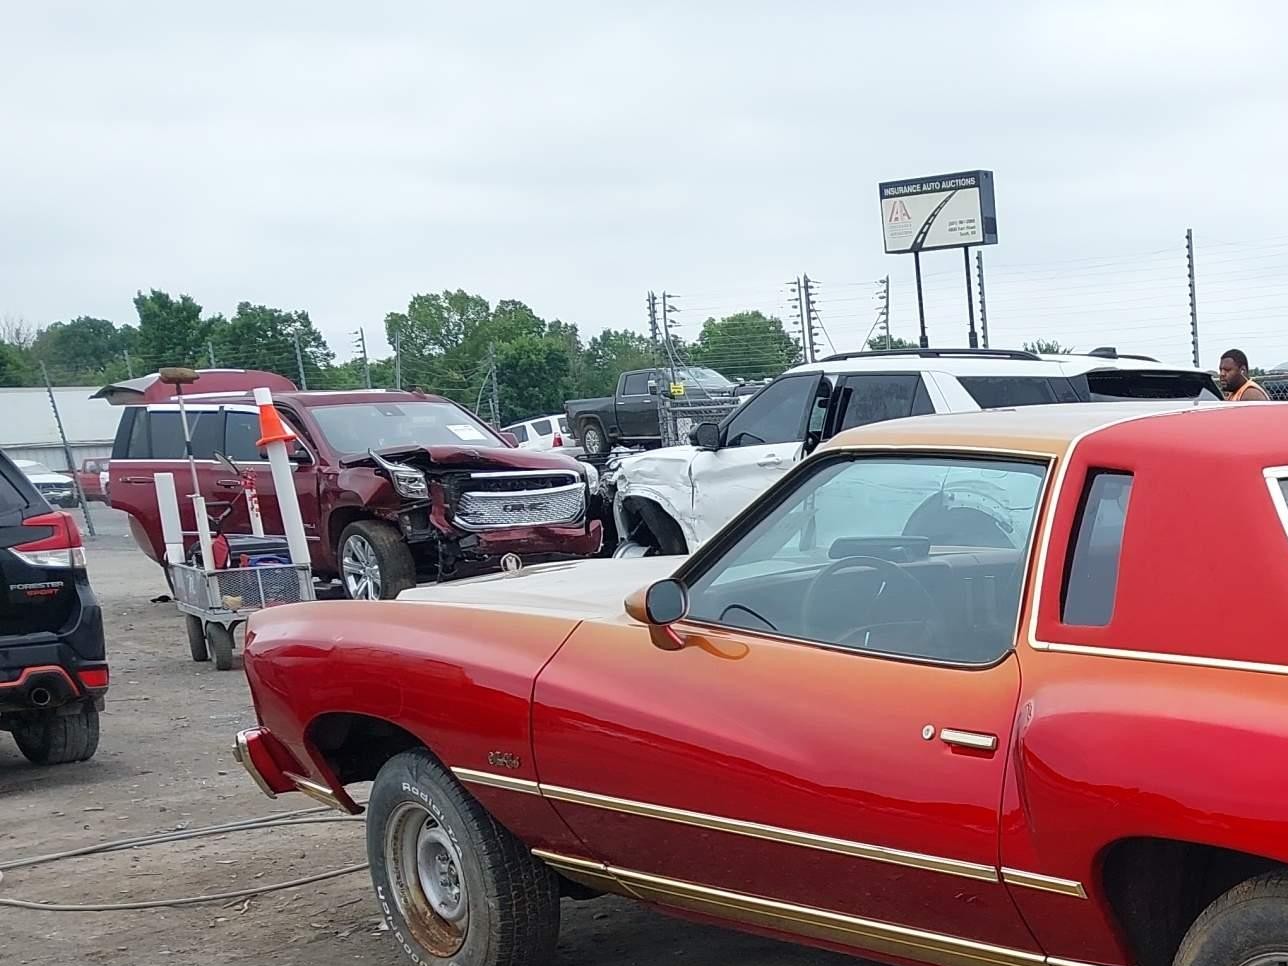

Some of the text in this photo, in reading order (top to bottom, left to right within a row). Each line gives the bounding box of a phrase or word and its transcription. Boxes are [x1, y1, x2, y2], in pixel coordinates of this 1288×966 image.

[884, 177, 976, 195] INSURANCE AUTO AUCTIONS
[9, 581, 64, 590] FORESTER
